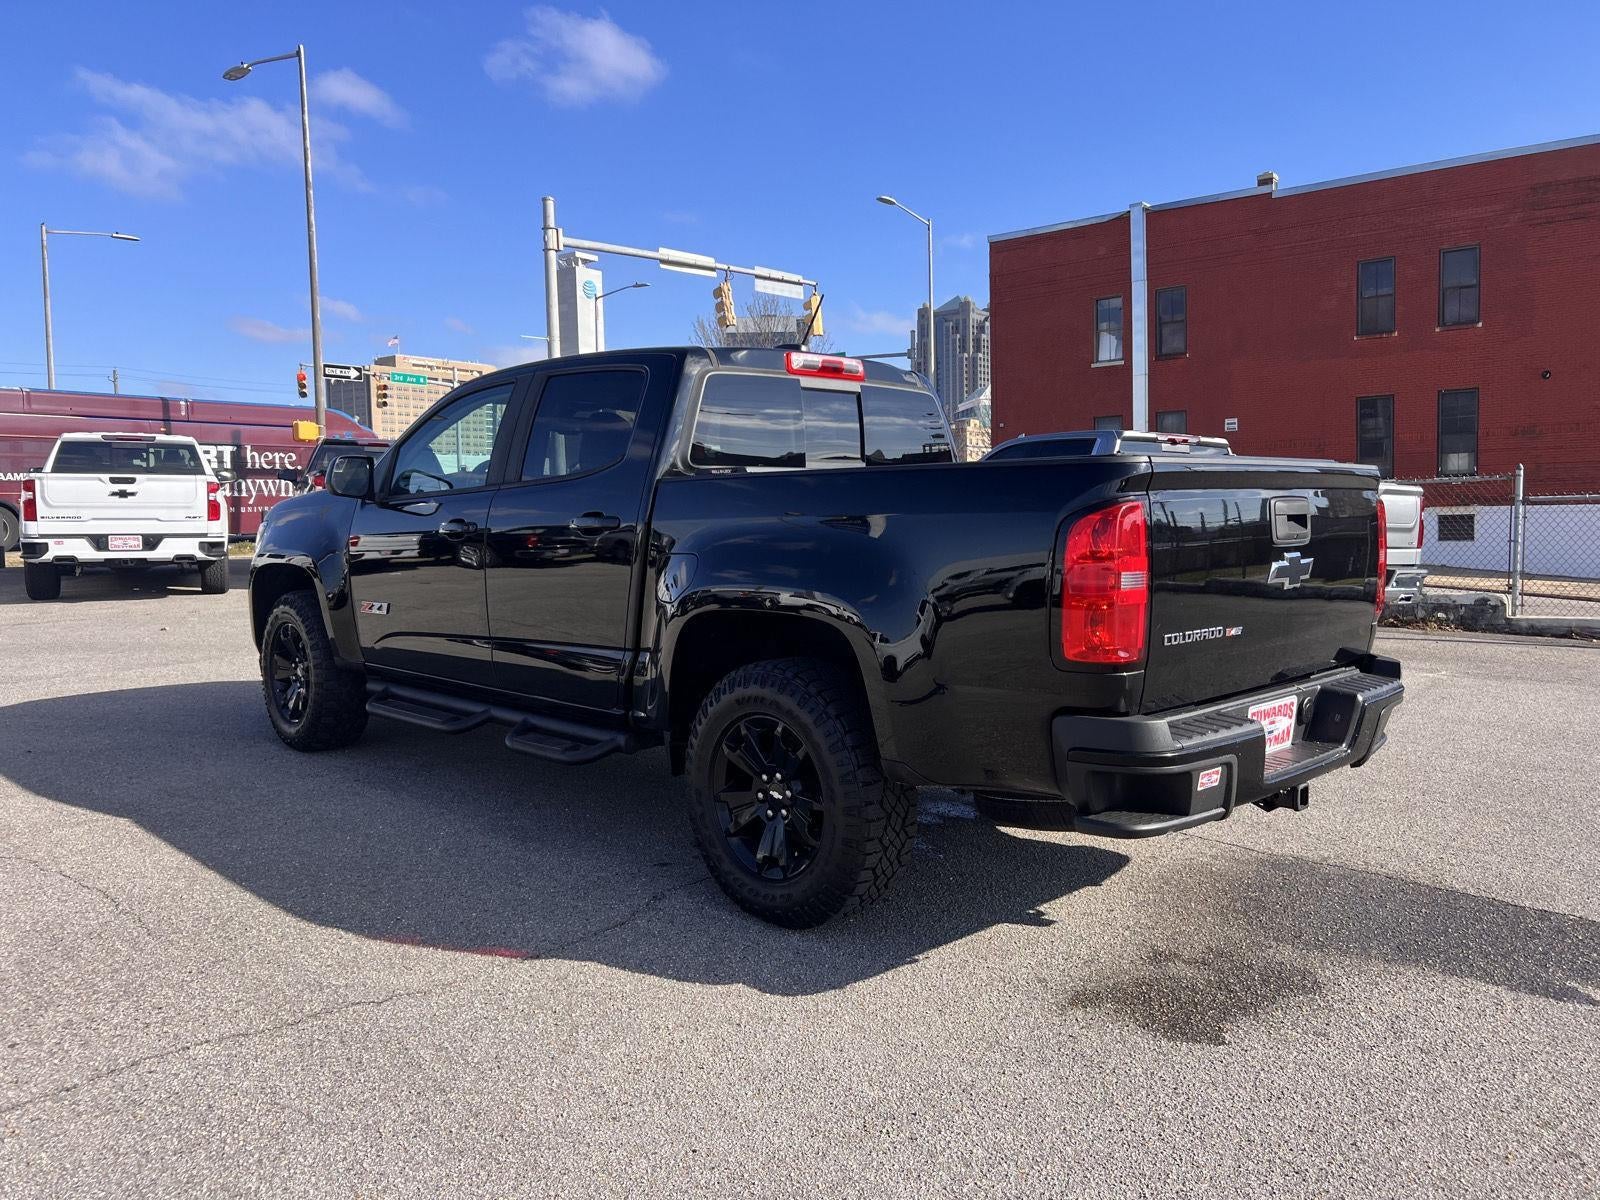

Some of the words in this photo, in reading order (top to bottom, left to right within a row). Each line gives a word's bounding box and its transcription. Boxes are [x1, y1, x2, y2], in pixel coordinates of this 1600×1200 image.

[201, 445, 237, 469] RT
[244, 445, 303, 470] here.
[1164, 626, 1224, 646] COLORADO
